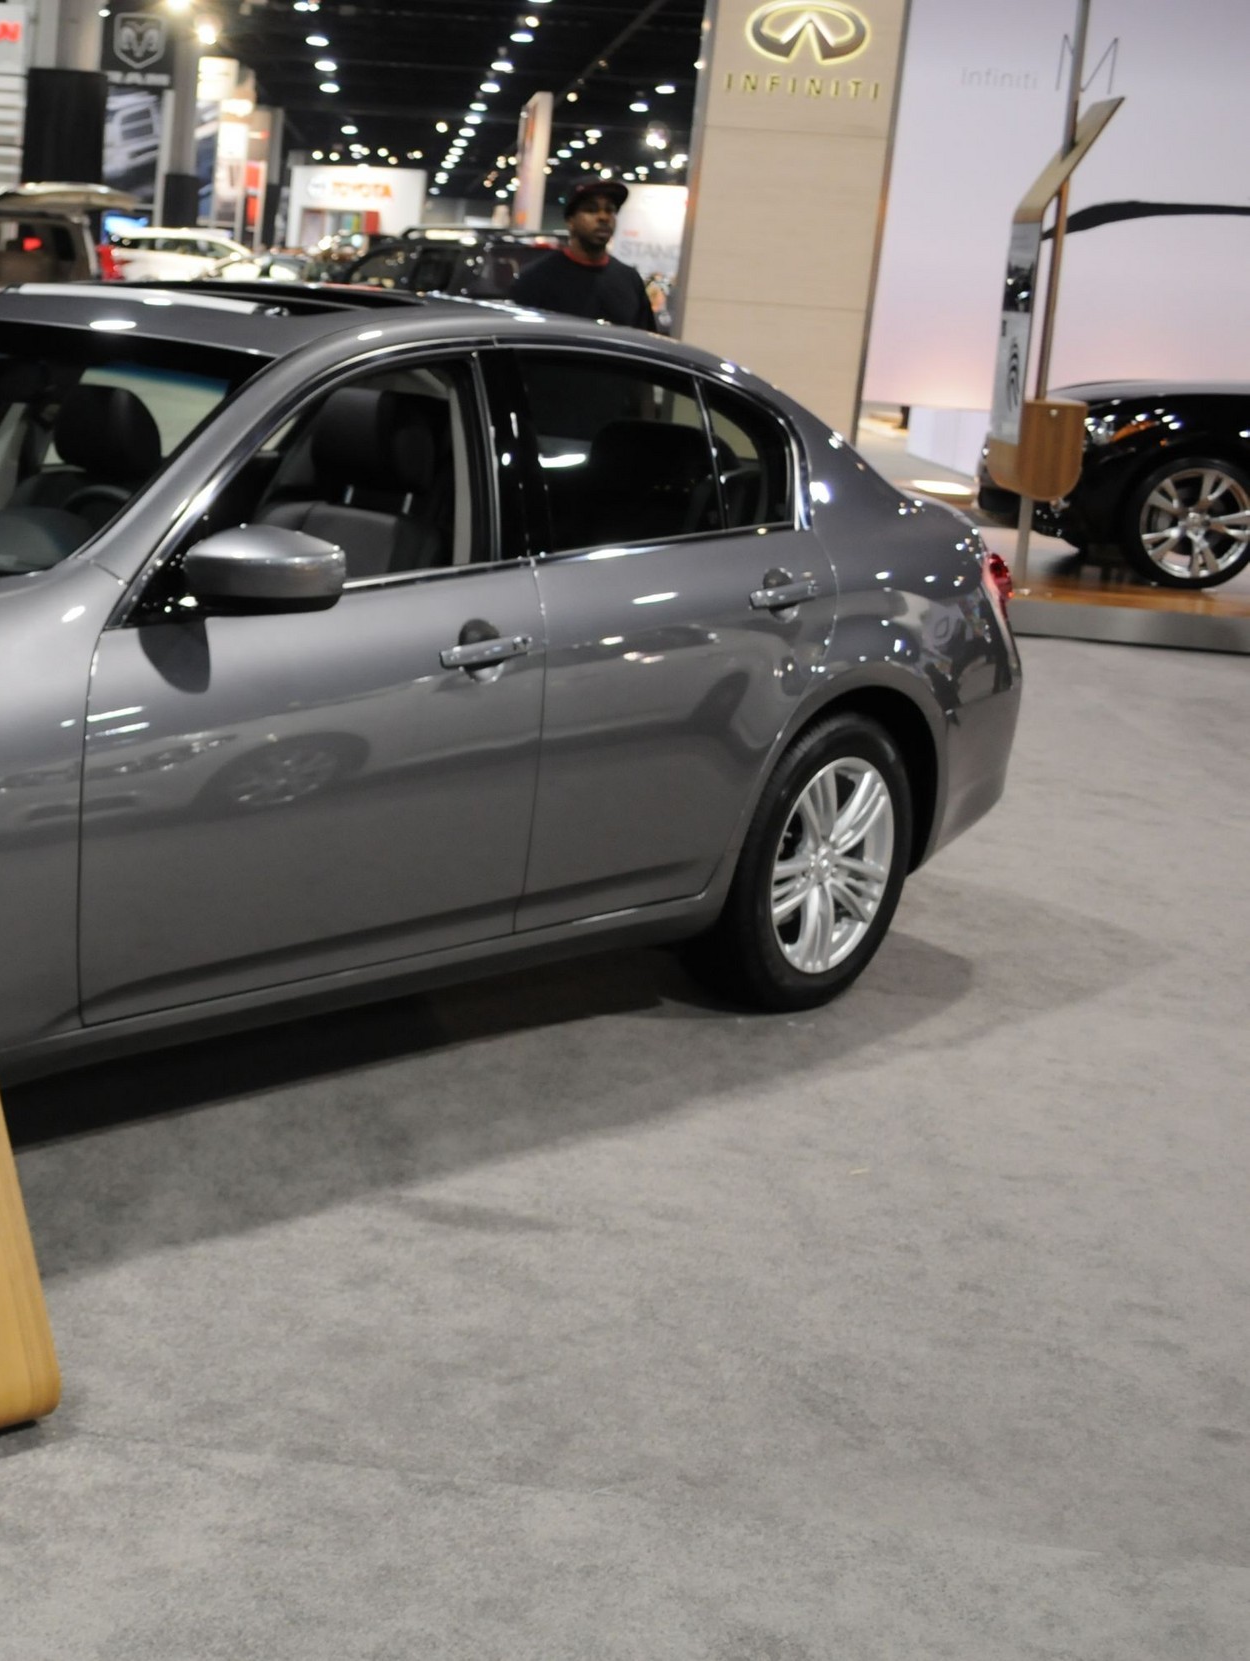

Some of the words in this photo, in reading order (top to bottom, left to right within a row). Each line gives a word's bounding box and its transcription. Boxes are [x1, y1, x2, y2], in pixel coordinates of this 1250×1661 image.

[108, 70, 170, 86] RAM
[725, 72, 879, 99] INFINITI
[959, 66, 1039, 90] Infiniti
[331, 181, 393, 199] TOYOTA
